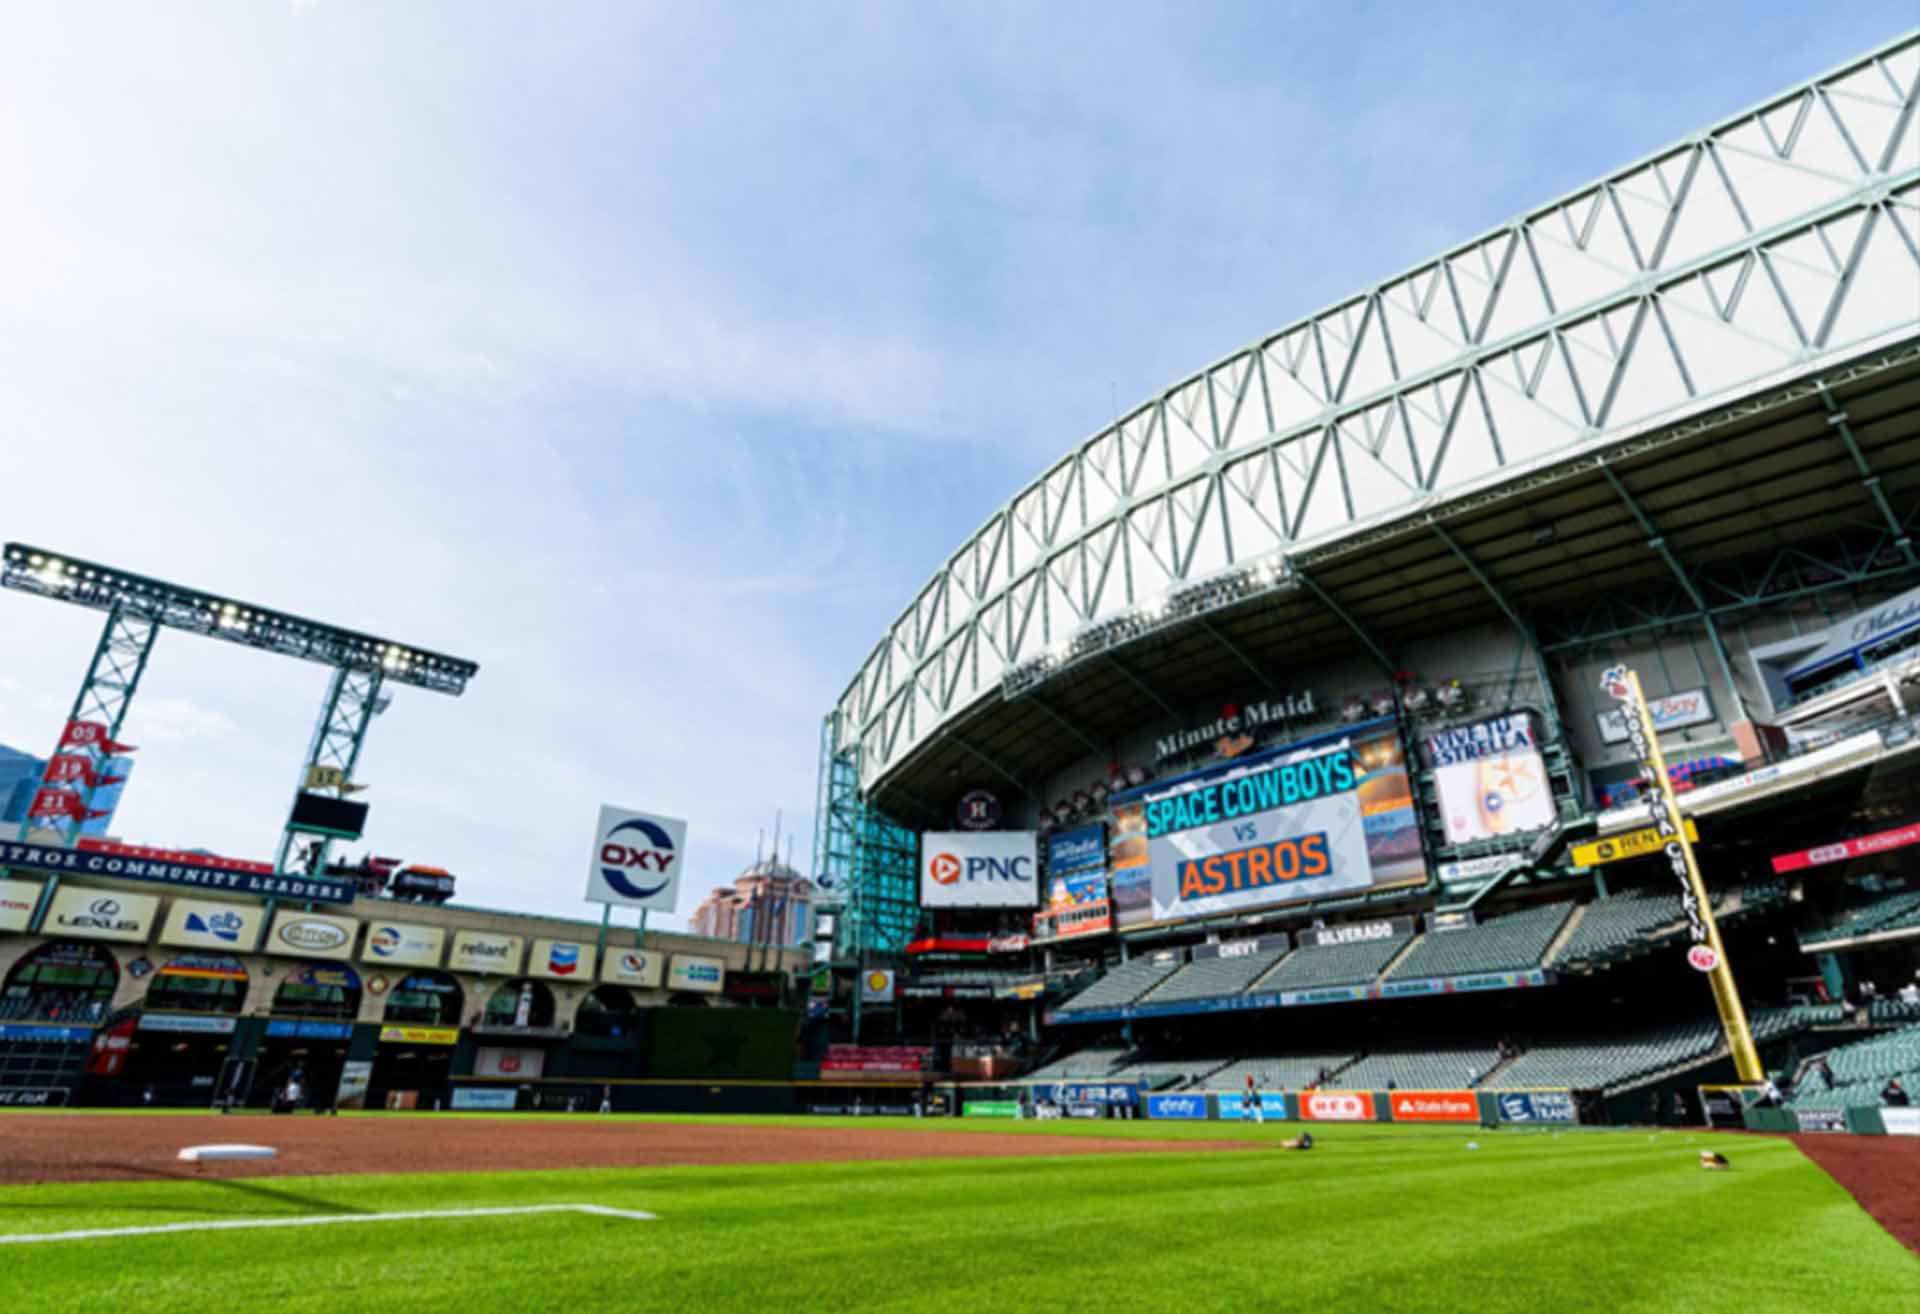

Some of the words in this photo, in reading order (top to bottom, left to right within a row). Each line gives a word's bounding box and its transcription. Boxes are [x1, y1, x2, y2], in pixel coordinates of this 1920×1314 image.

[1155, 716, 1240, 760] Minute
[1243, 690, 1314, 726] Maid
[1484, 715, 1511, 737] TU
[60, 761, 82, 776] 19
[43, 793, 64, 808] 21
[1146, 786, 1220, 836] SPACE
[1221, 752, 1354, 817] COWBOYS
[1232, 821, 1258, 841] VS
[600, 843, 675, 873] OXY
[1180, 835, 1329, 898] ASTROS
[0, 846, 78, 867] TROS
[88, 857, 241, 887] COMMUNITY
[249, 877, 345, 899] LEADERS
[966, 857, 1033, 882] PNC
[57, 913, 140, 931] LEXUS
[208, 911, 244, 931] slb
[1317, 921, 1392, 946] SILVERADO
[460, 941, 509, 958] reliant
[1218, 939, 1257, 958] CHEVY
